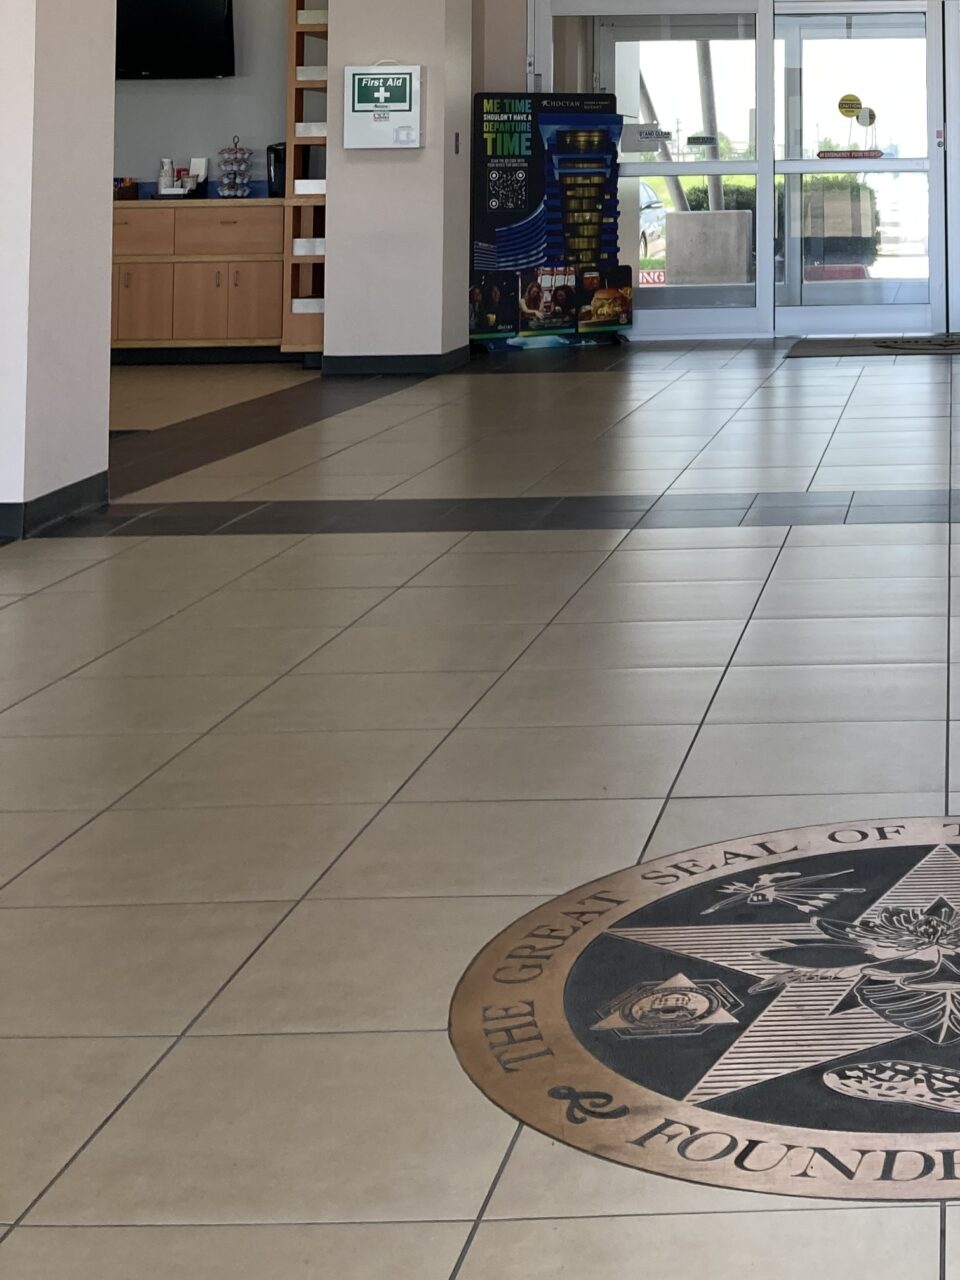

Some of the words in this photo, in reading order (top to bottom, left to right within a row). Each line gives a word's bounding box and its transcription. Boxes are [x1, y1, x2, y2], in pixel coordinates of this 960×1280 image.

[361, 78, 383, 87] First
[386, 77, 402, 86] Aid
[483, 99, 501, 113] ME
[504, 99, 532, 113] TIME
[483, 122, 532, 132] DEPARTURE
[483, 133, 532, 156] TIME
[827, 823, 908, 844] OF
[641, 840, 798, 886] SEAL
[492, 890, 630, 985] GREAT
[482, 999, 556, 1074] THE
